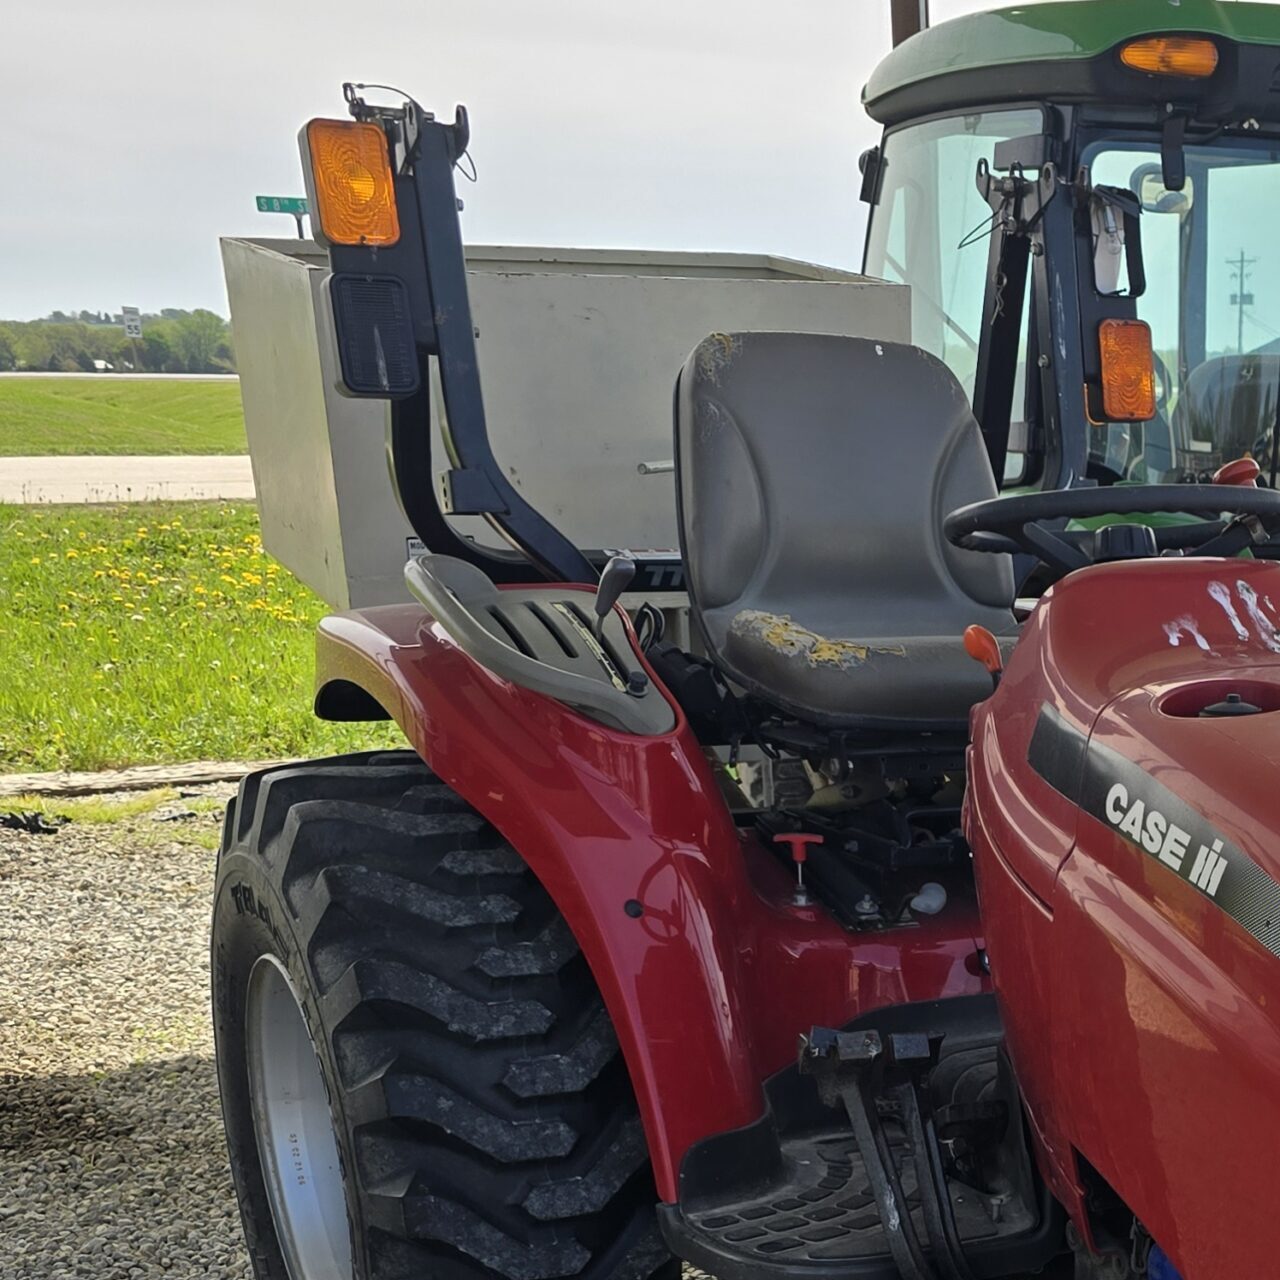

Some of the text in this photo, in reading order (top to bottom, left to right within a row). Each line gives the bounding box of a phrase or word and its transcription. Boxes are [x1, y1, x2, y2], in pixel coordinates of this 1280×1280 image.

[260, 198, 268, 210] S
[127, 324, 140, 335] 55
[1106, 783, 1191, 871] CASE
